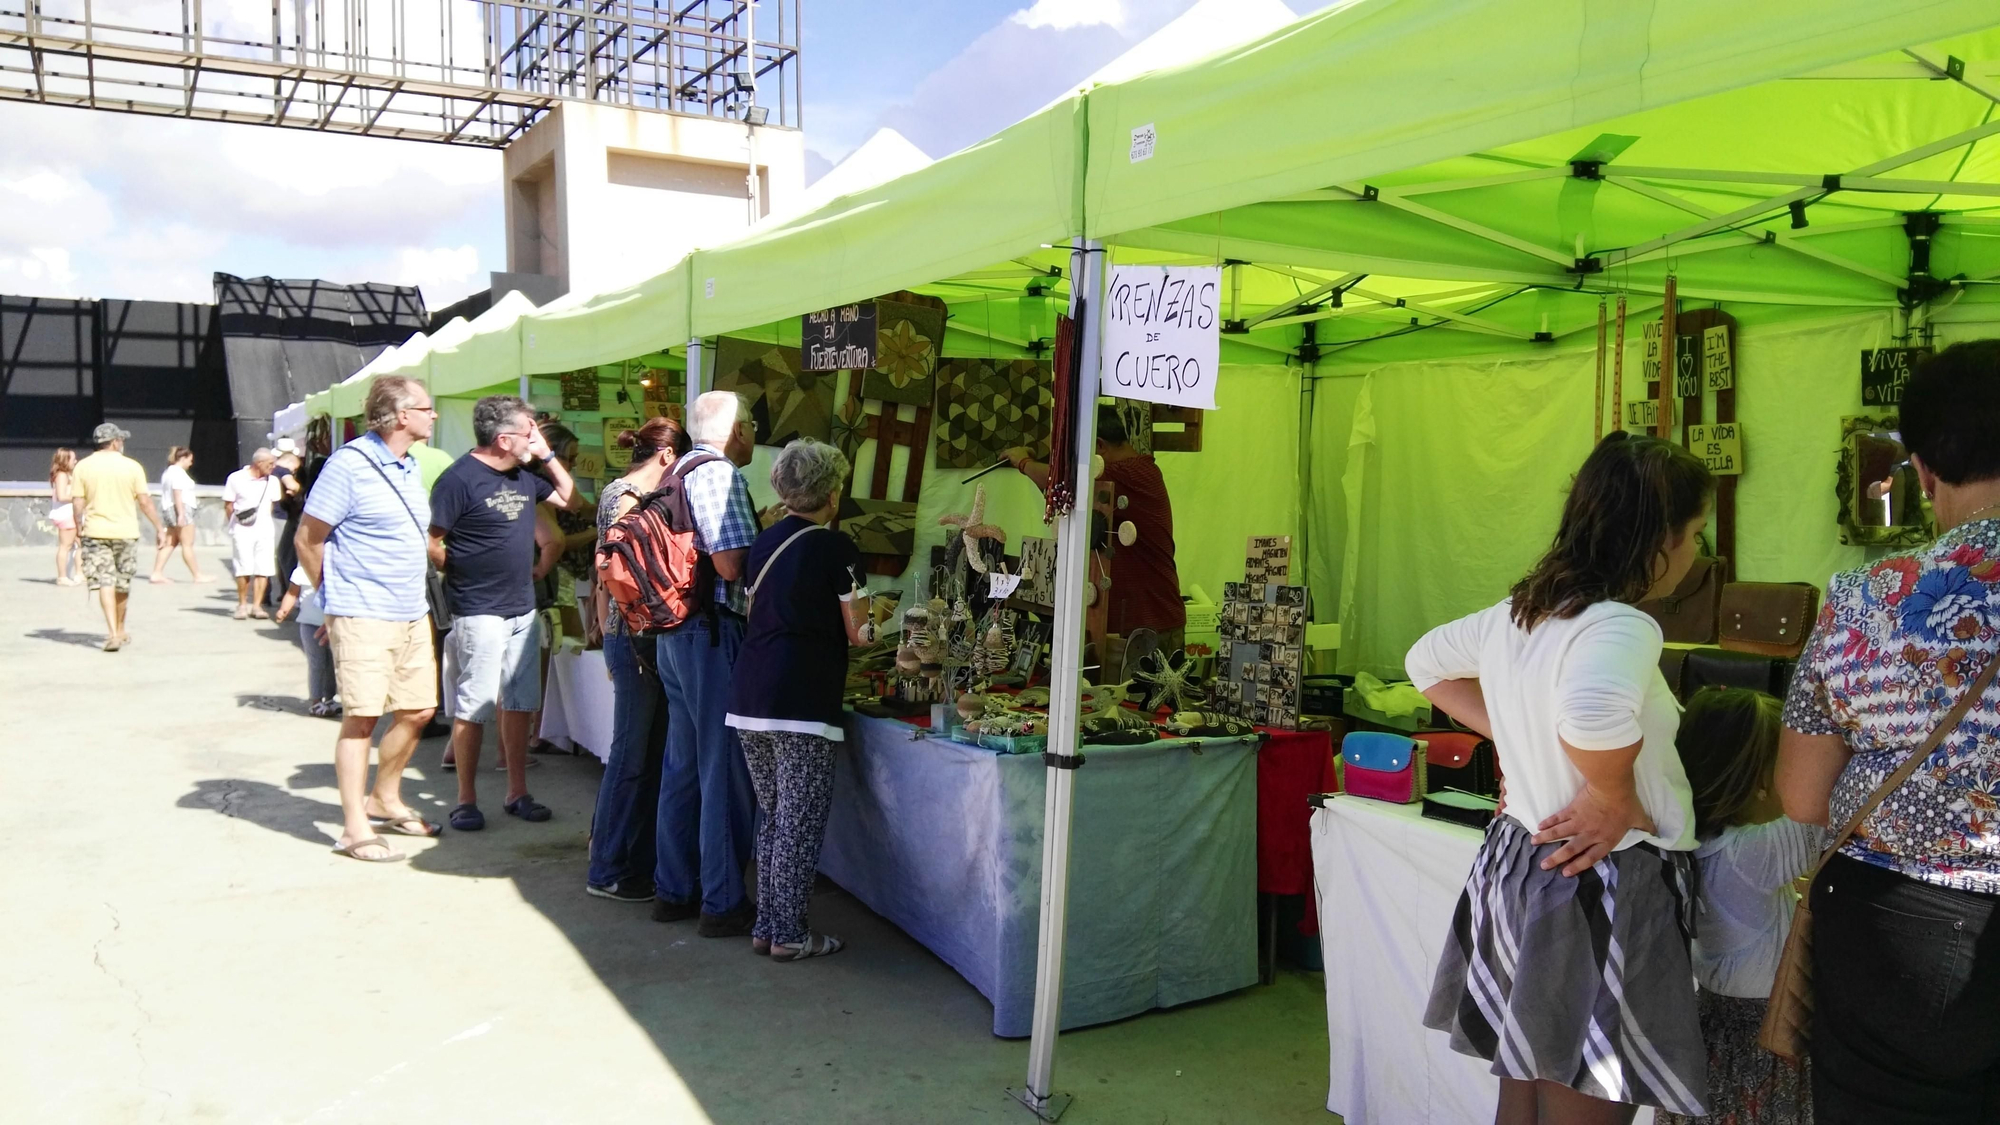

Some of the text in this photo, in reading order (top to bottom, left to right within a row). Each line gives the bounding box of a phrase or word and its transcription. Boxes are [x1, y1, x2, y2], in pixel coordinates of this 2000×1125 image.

[1108, 273, 1215, 330] TRENZAS
[830, 308, 836, 322] A
[840, 304, 859, 322] MANO
[824, 322, 836, 339] EN
[1146, 332, 1160, 343] DE
[1647, 341, 1658, 358] LA
[1682, 336, 1692, 357] I
[810, 343, 869, 370] FUERTEVENTURA
[1706, 351, 1727, 369] THE
[1115, 351, 1200, 394] CUERO
[1709, 366, 1730, 389] BEST
[1893, 368, 1911, 386] LA
[1678, 376, 1698, 397] YOU
[1692, 428, 1704, 443] LA
[1706, 442, 1722, 455] ES
